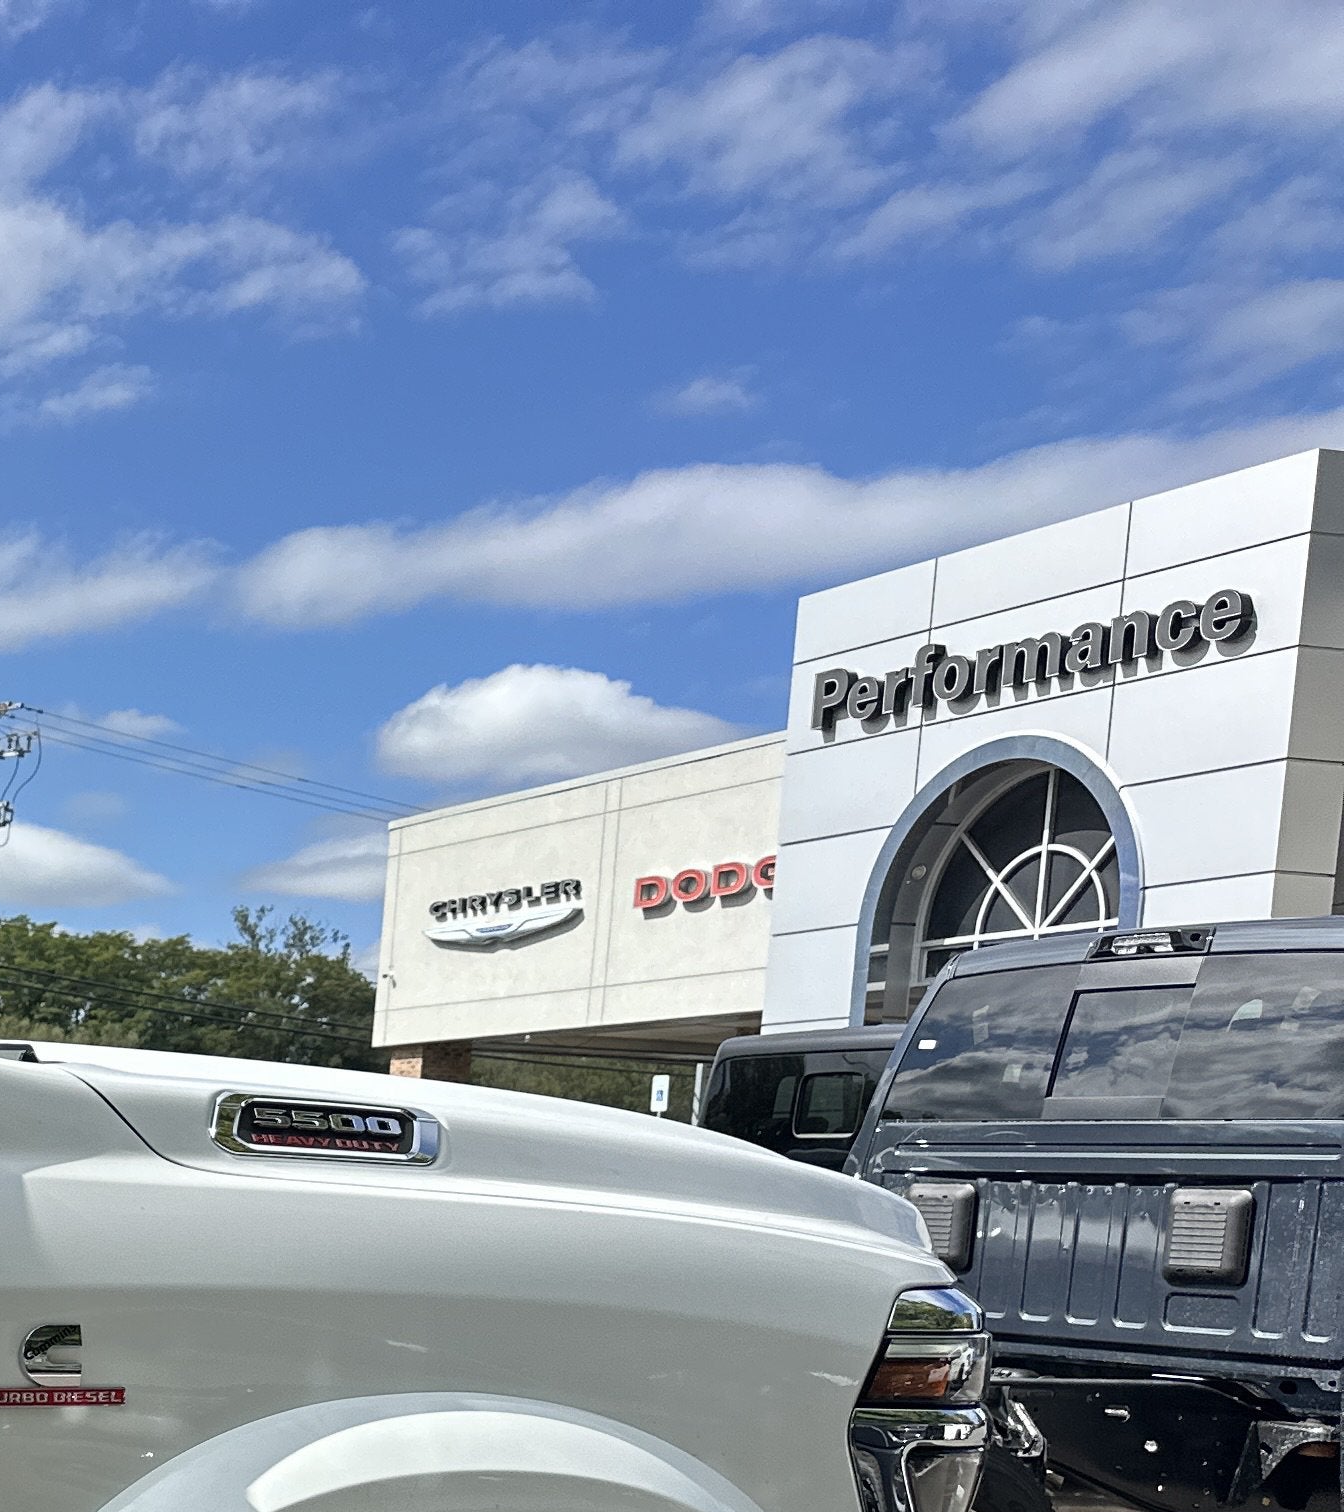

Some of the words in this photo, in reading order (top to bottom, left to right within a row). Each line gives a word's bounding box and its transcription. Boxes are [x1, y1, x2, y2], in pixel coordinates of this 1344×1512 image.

[810, 588, 1256, 731] Performance
[428, 878, 583, 918] CHRYSLER
[252, 1107, 403, 1136] 5500
[250, 1133, 332, 1147] HEAVY
[335, 1138, 400, 1152] DUTY
[23, 1324, 79, 1361] Cummins
[53, 1391, 122, 1404] DIESEL
